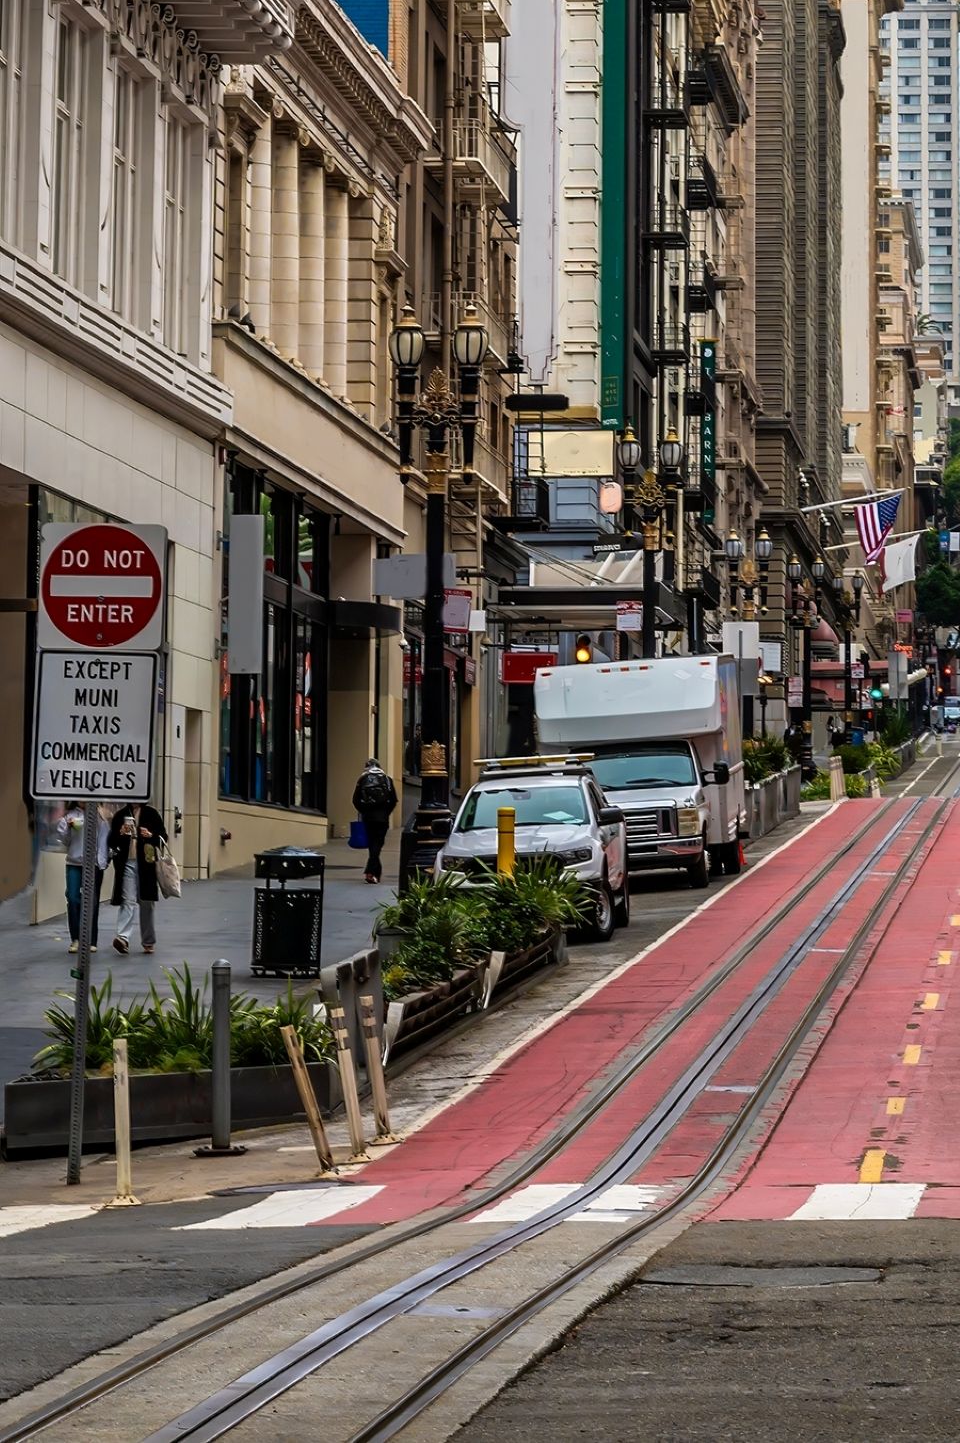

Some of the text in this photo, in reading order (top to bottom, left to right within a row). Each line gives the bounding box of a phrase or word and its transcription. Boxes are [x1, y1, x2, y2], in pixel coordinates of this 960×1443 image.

[61, 549, 145, 569] DO NOT
[67, 604, 134, 624] ENTER
[63, 660, 133, 680] EXCEPT
[74, 688, 118, 708] MUNI
[69, 715, 121, 735] TAXIS
[41, 741, 146, 763] COMMERCIAL
[49, 769, 136, 790] VEHICLES
